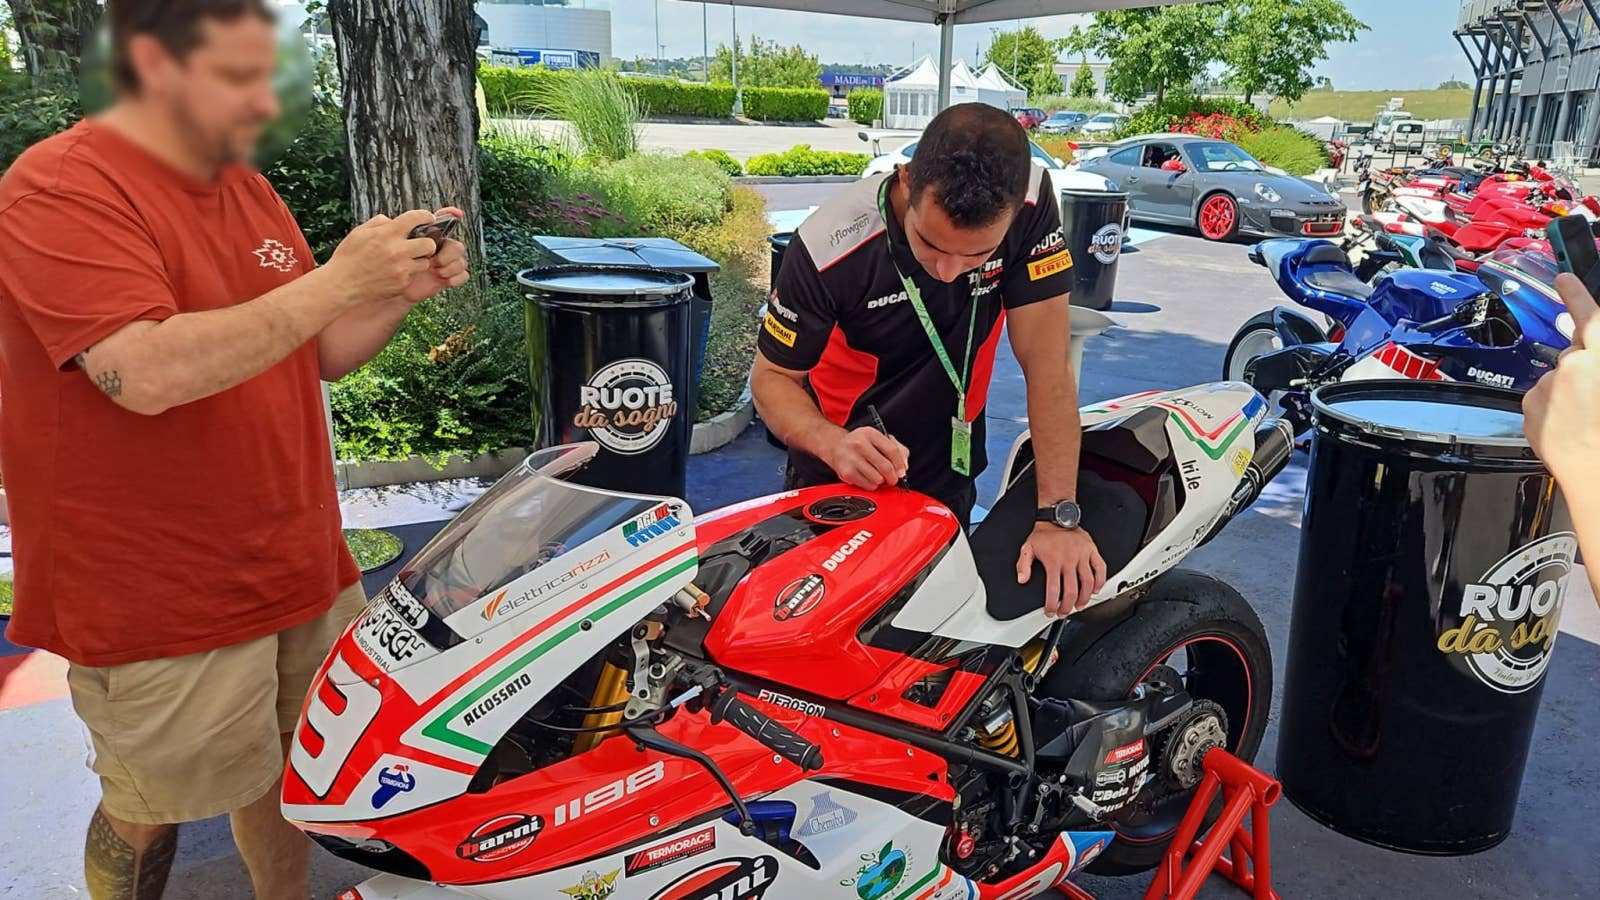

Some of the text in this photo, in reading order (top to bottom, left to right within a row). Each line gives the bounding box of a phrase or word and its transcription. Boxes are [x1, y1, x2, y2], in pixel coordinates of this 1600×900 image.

[834, 75, 861, 85] MADE
[834, 216, 870, 245] flowgen
[1091, 234, 1120, 246] RUOT
[1033, 255, 1071, 276] PIRELLI
[867, 290, 908, 309] DUCA
[1467, 366, 1515, 386] DUCATI
[580, 383, 674, 410] RUOTE
[573, 400, 679, 433] da sogno
[821, 529, 873, 573] DUCATI
[497, 549, 611, 616] elettricarizzi
[775, 574, 822, 620] barni
[1459, 579, 1569, 621] RUOT
[1437, 614, 1503, 655] da
[463, 673, 532, 727] ACCOSSATO
[757, 688, 827, 719] PIEROBON
[554, 759, 665, 828] 1198
[1102, 786, 1130, 801] Beta
[459, 814, 542, 858] barni
[647, 831, 711, 862] TERMORACE
